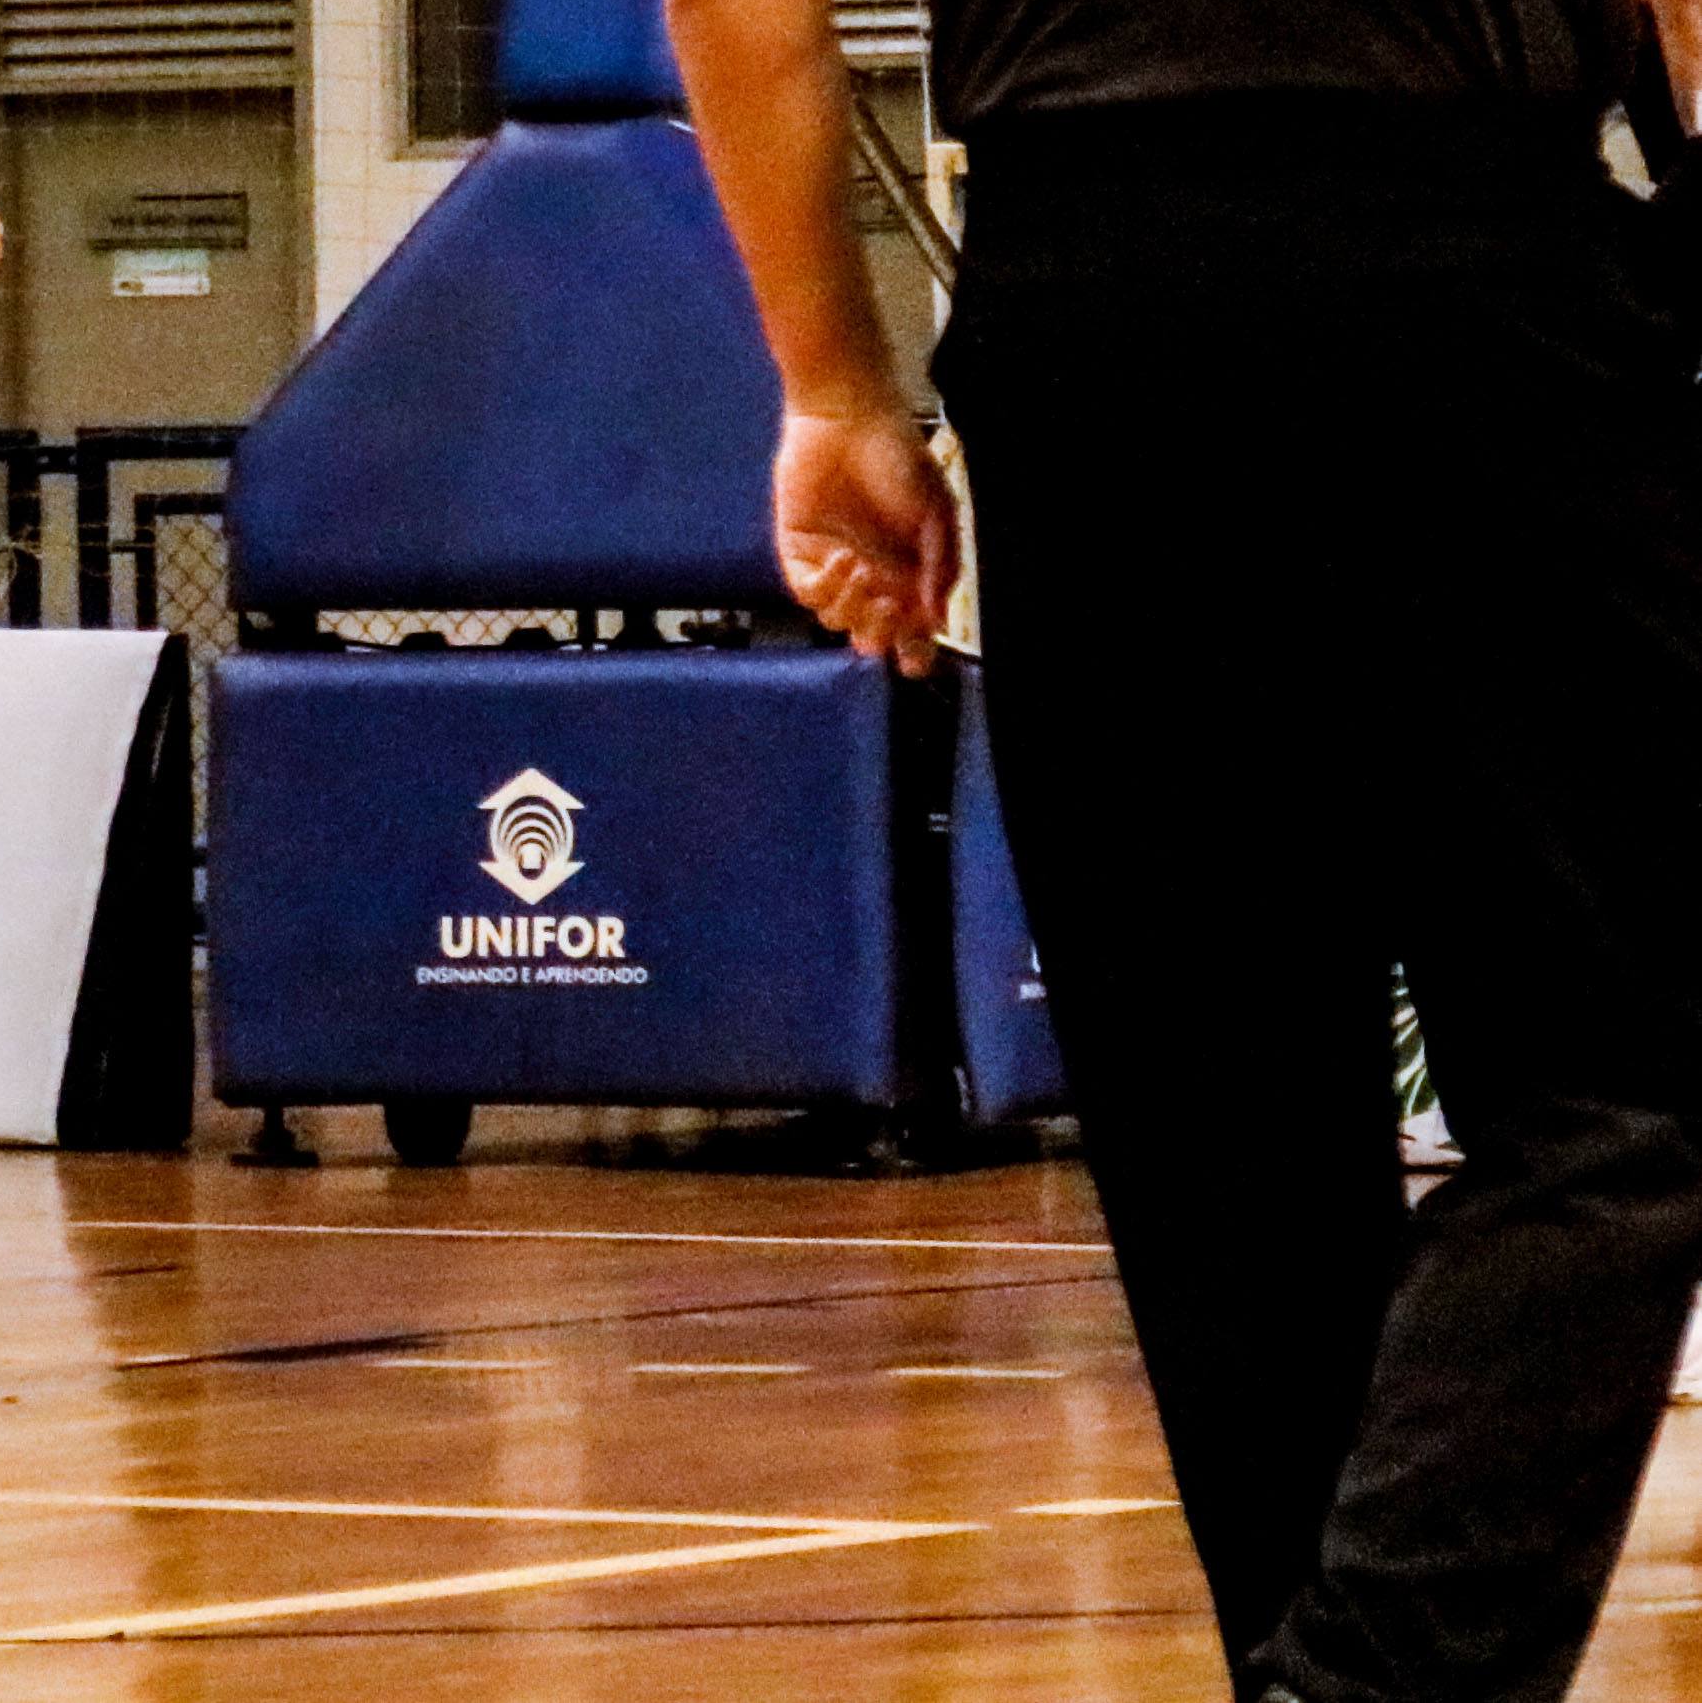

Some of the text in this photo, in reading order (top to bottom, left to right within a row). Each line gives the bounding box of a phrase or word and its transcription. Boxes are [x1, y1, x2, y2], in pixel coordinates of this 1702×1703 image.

[440, 915, 626, 959] UNIFOR
[415, 965, 650, 985] ENSINANDO E APRENDENDO
